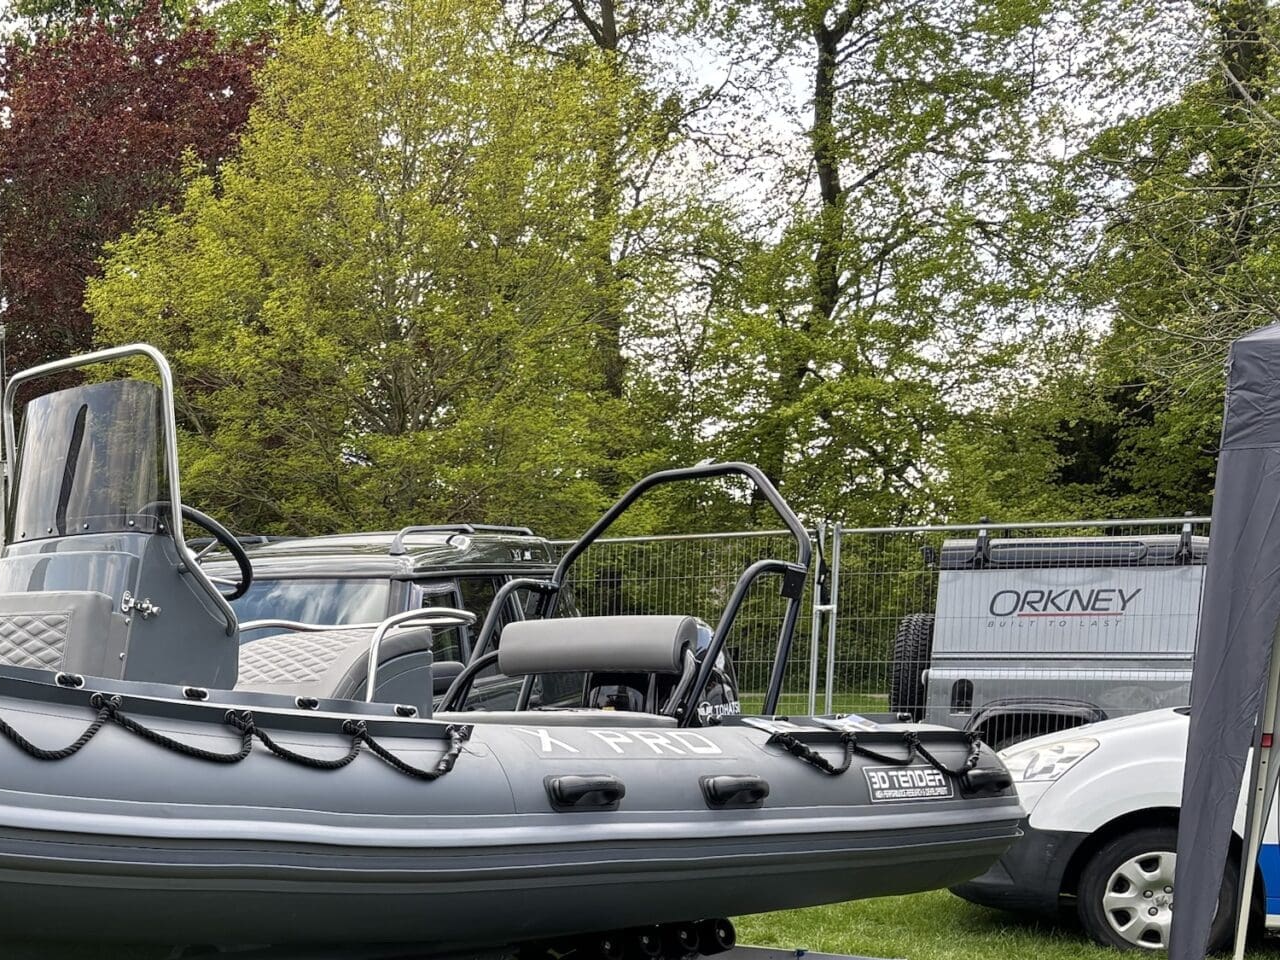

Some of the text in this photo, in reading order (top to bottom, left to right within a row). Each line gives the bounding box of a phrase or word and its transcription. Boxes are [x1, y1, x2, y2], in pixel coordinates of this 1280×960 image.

[989, 588, 1143, 617] ORKNEY
[987, 620, 1121, 628] BUILT TO LAST
[512, 728, 723, 754] X PRO
[868, 769, 946, 789] 3D TENDER
